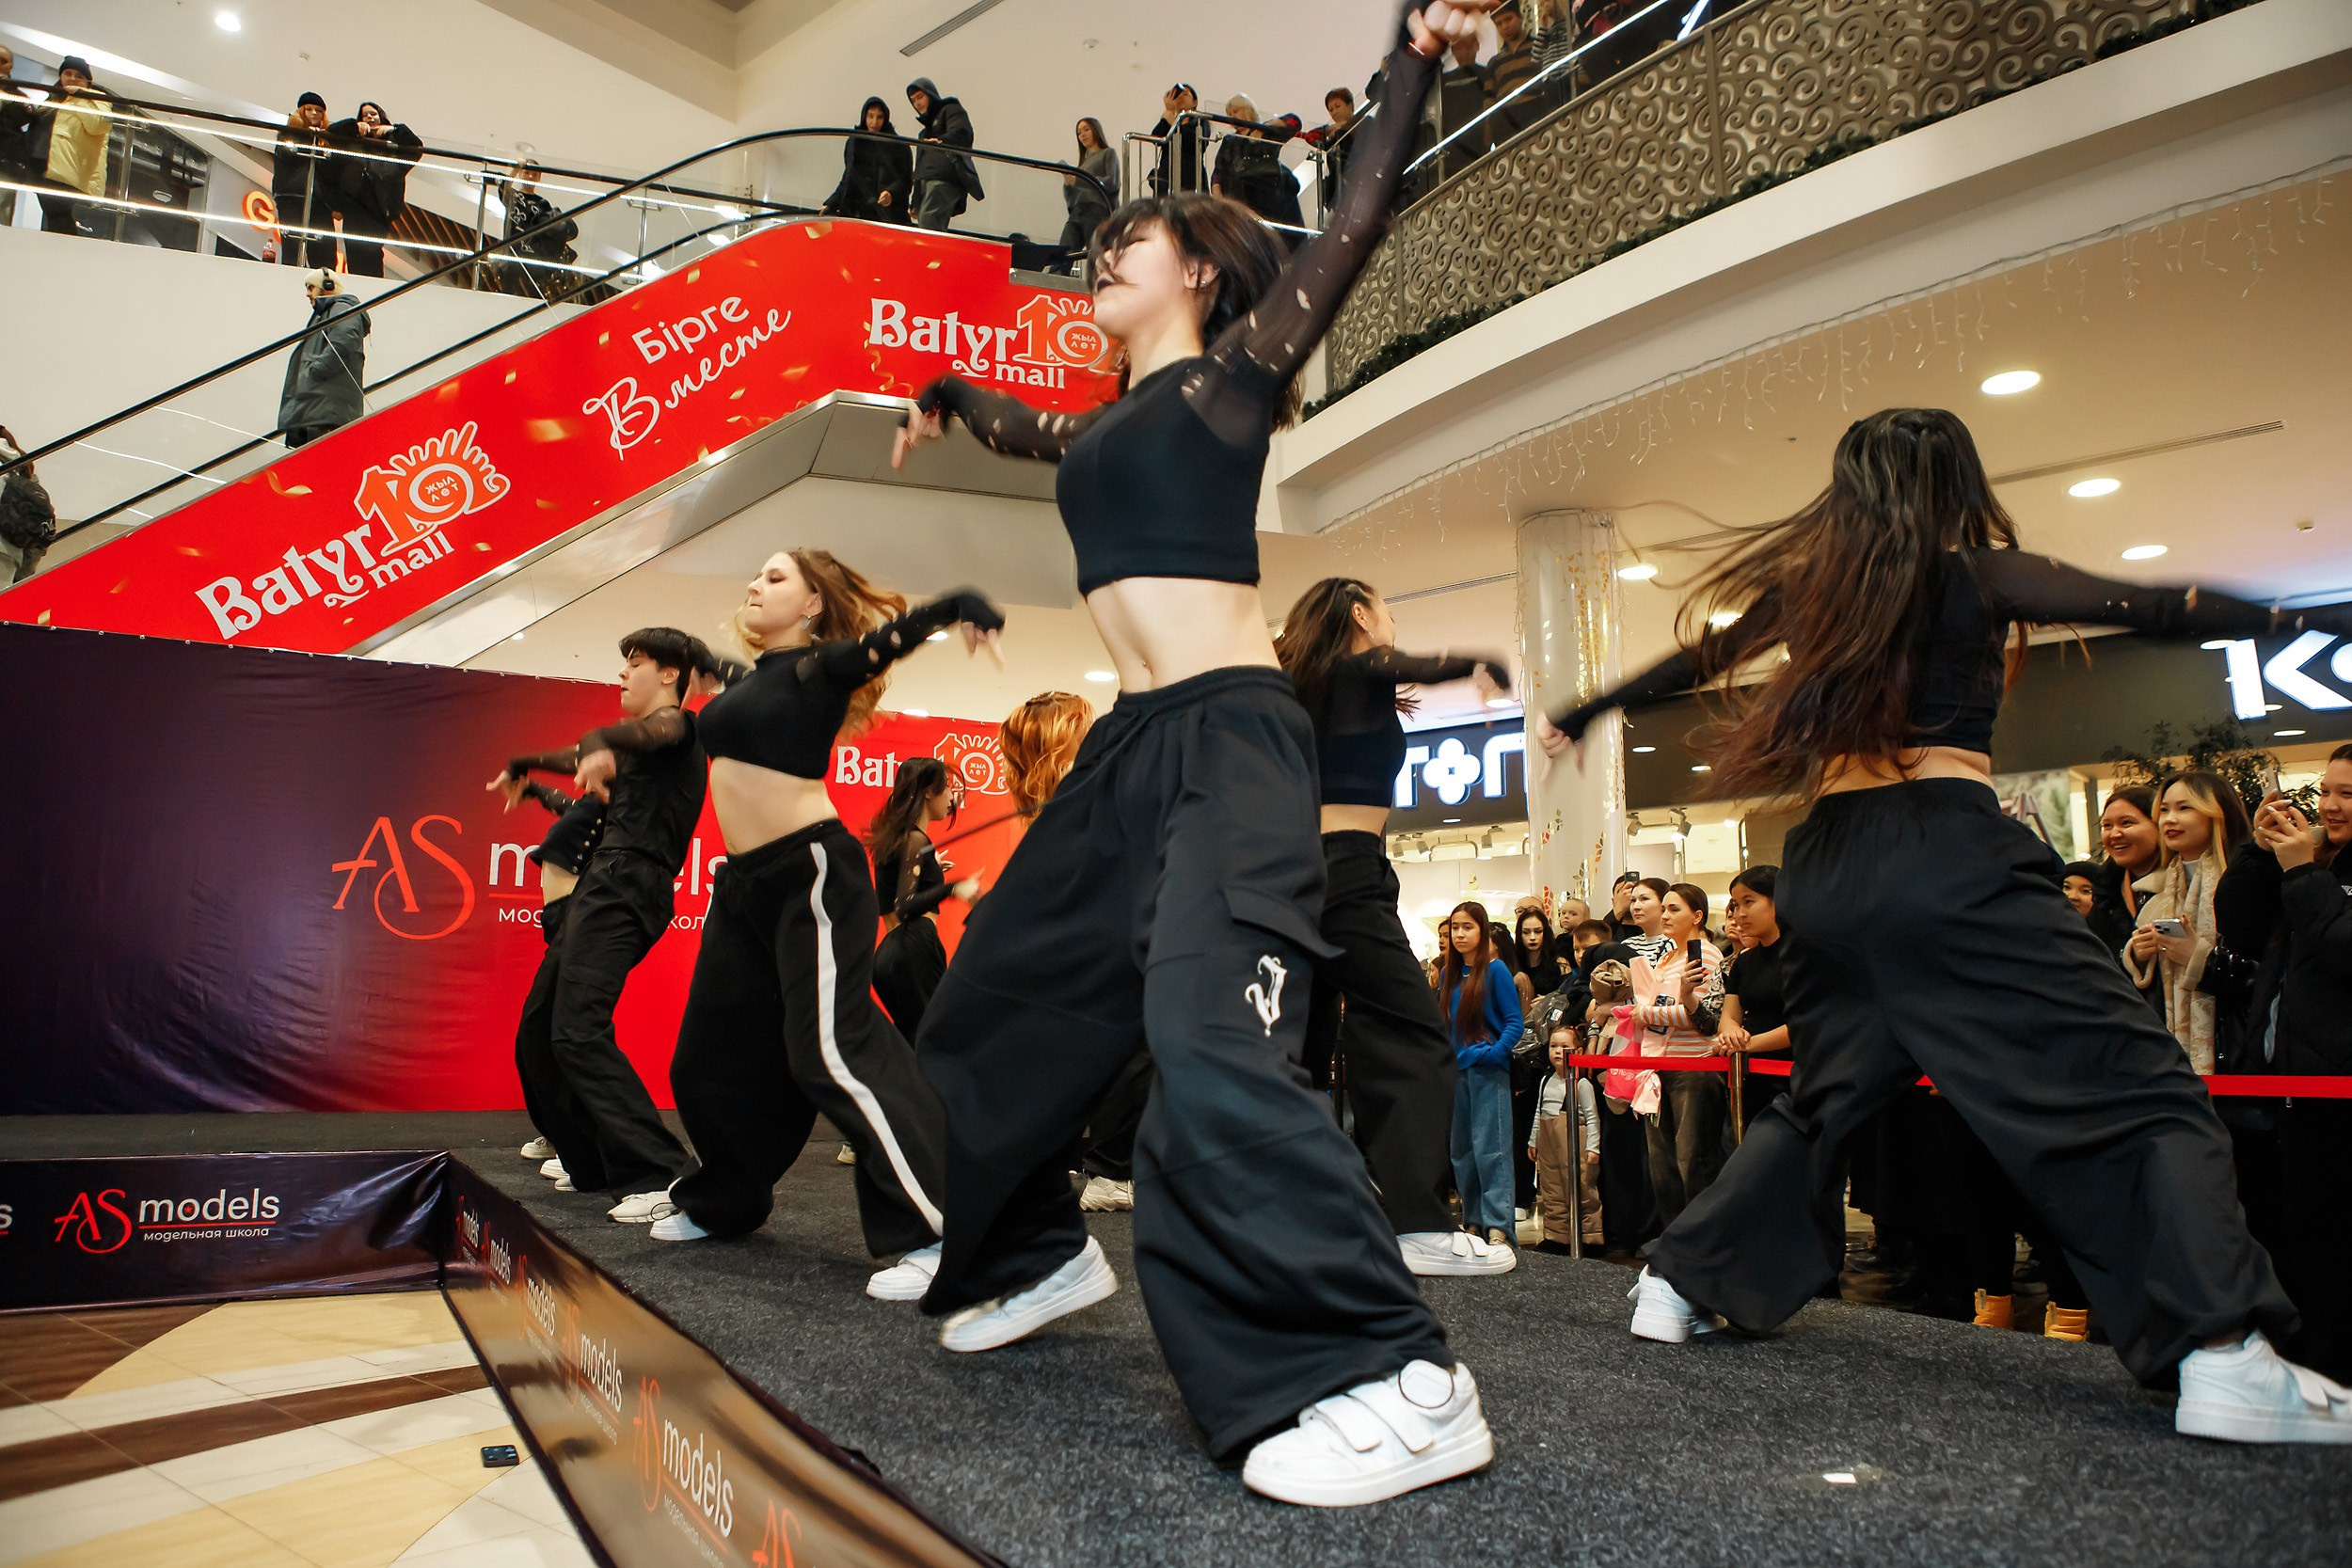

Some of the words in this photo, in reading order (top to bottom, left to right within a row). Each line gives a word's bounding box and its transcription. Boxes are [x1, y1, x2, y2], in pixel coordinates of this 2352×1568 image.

[631, 296, 750, 365] Бірге
[868, 297, 1019, 378] Batyr
[582, 309, 792, 461] Вместе
[994, 363, 1065, 388] mall
[195, 522, 377, 640] Batyr
[368, 530, 455, 589] mall
[835, 745, 903, 788] Bat
[331, 814, 476, 941] AS
[54, 1188, 133, 1254] AS
[139, 1187, 280, 1223] models
[144, 1229, 222, 1243] модельная
[226, 1227, 270, 1239] школа
[527, 1276, 556, 1338] models
[580, 1333, 623, 1413] models
[662, 1418, 734, 1538] models
